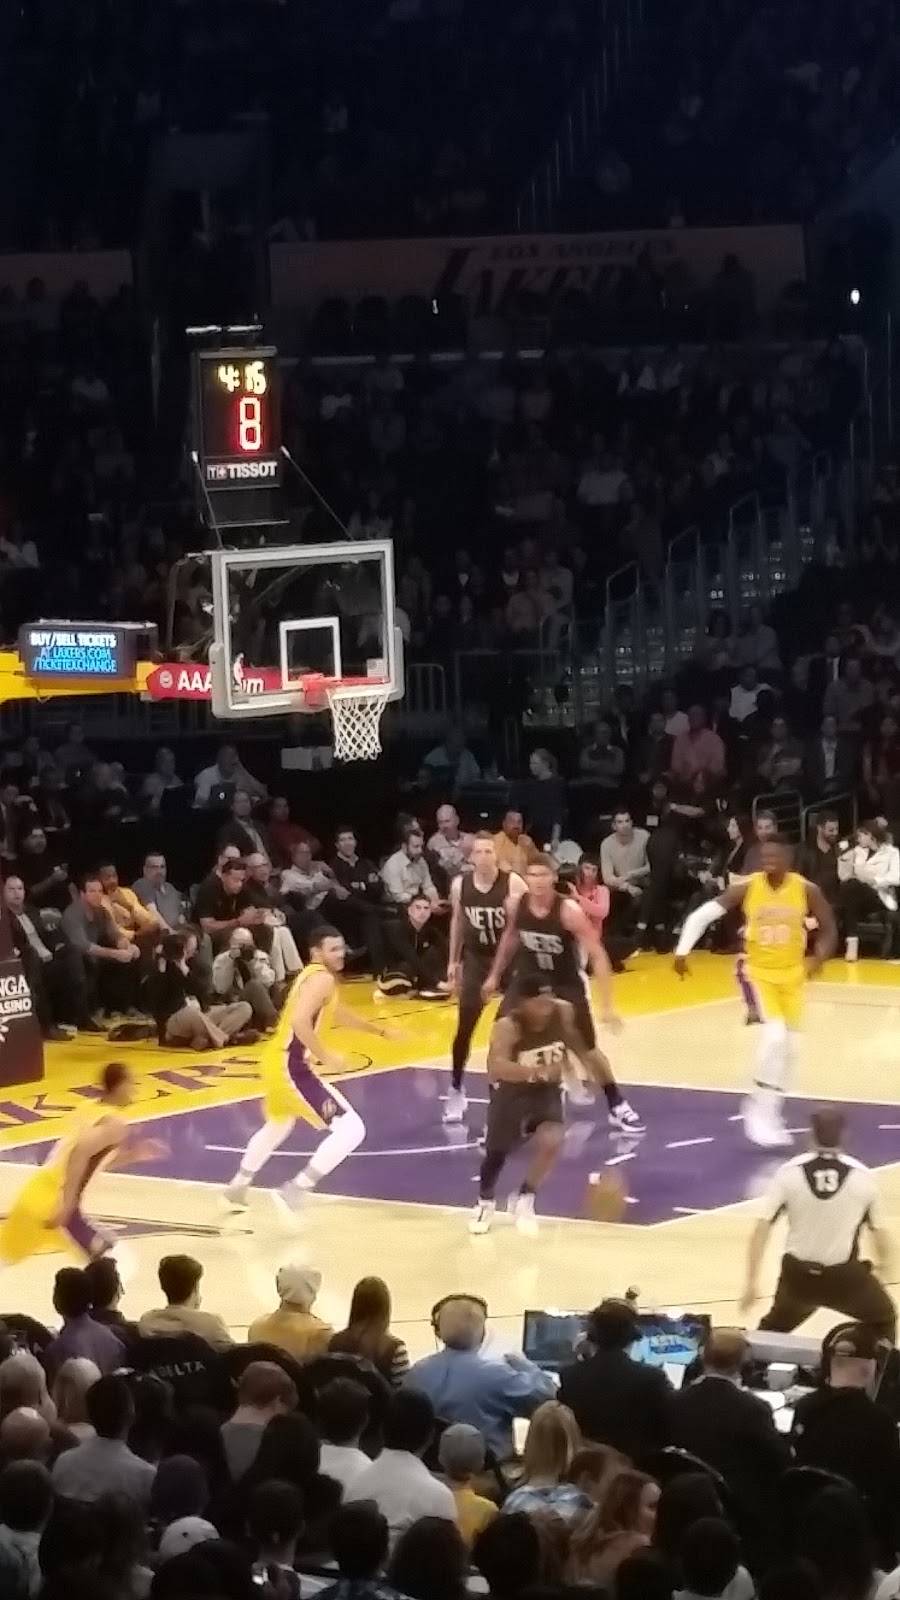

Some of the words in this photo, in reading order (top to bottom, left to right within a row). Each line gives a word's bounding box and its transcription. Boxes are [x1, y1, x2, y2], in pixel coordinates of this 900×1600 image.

[239, 397, 261, 451] 8
[229, 462, 278, 479] TISSOT
[77, 634, 117, 648] TICKETS
[465, 906, 505, 930] NETS
[812, 1168, 839, 1192] 13
